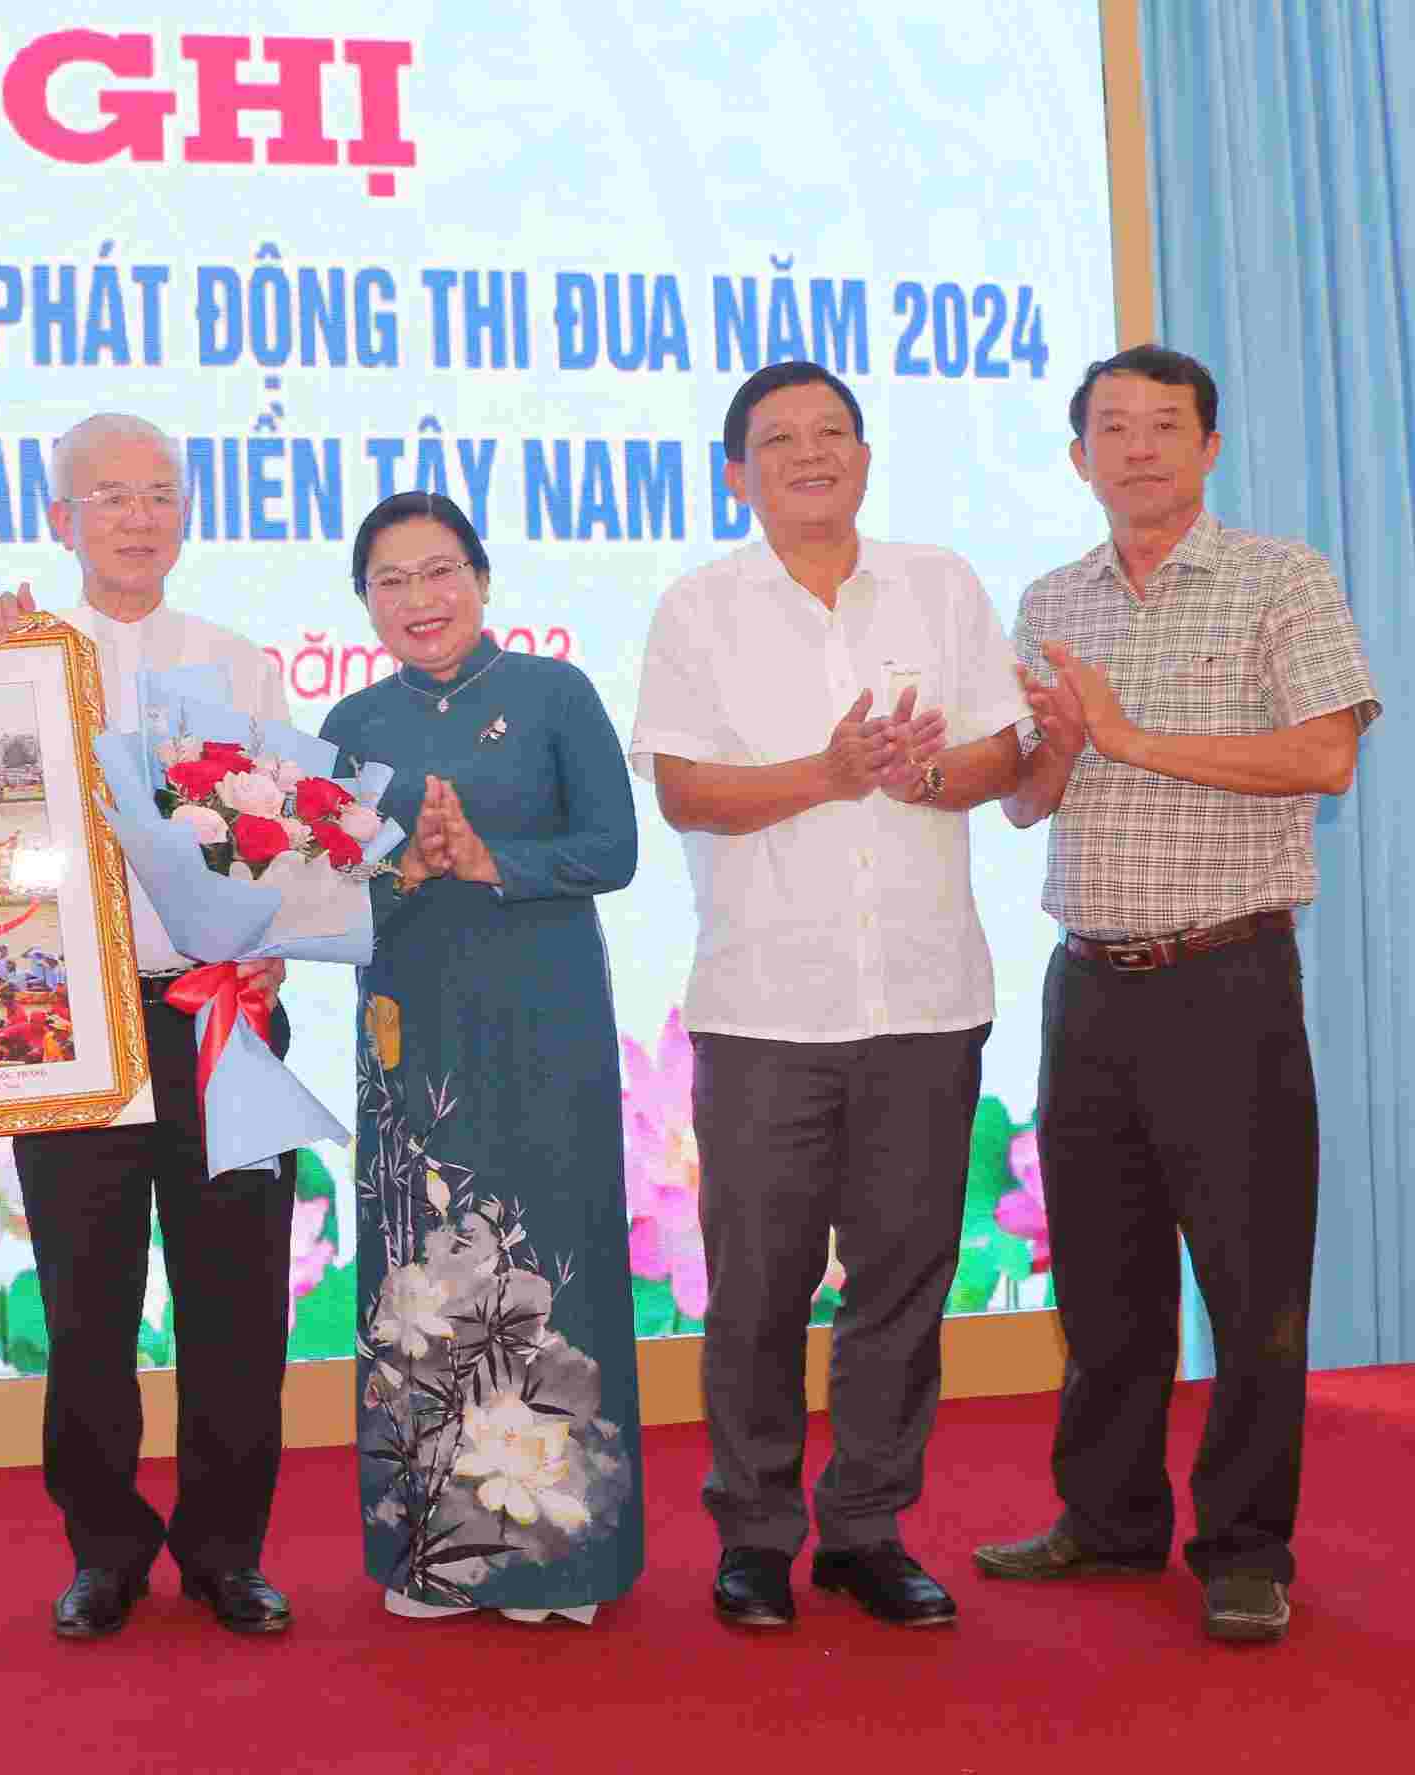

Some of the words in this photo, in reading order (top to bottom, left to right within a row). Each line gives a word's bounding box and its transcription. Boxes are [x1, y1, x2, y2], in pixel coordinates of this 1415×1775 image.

[196, 243, 399, 391] ĐỘNG
[423, 268, 529, 371] THI
[554, 270, 691, 372] ĐUA
[712, 253, 870, 375] NĂM
[893, 280, 1050, 380] 2024
[523, 437, 687, 541] NAM
[710, 440, 751, 541] B
